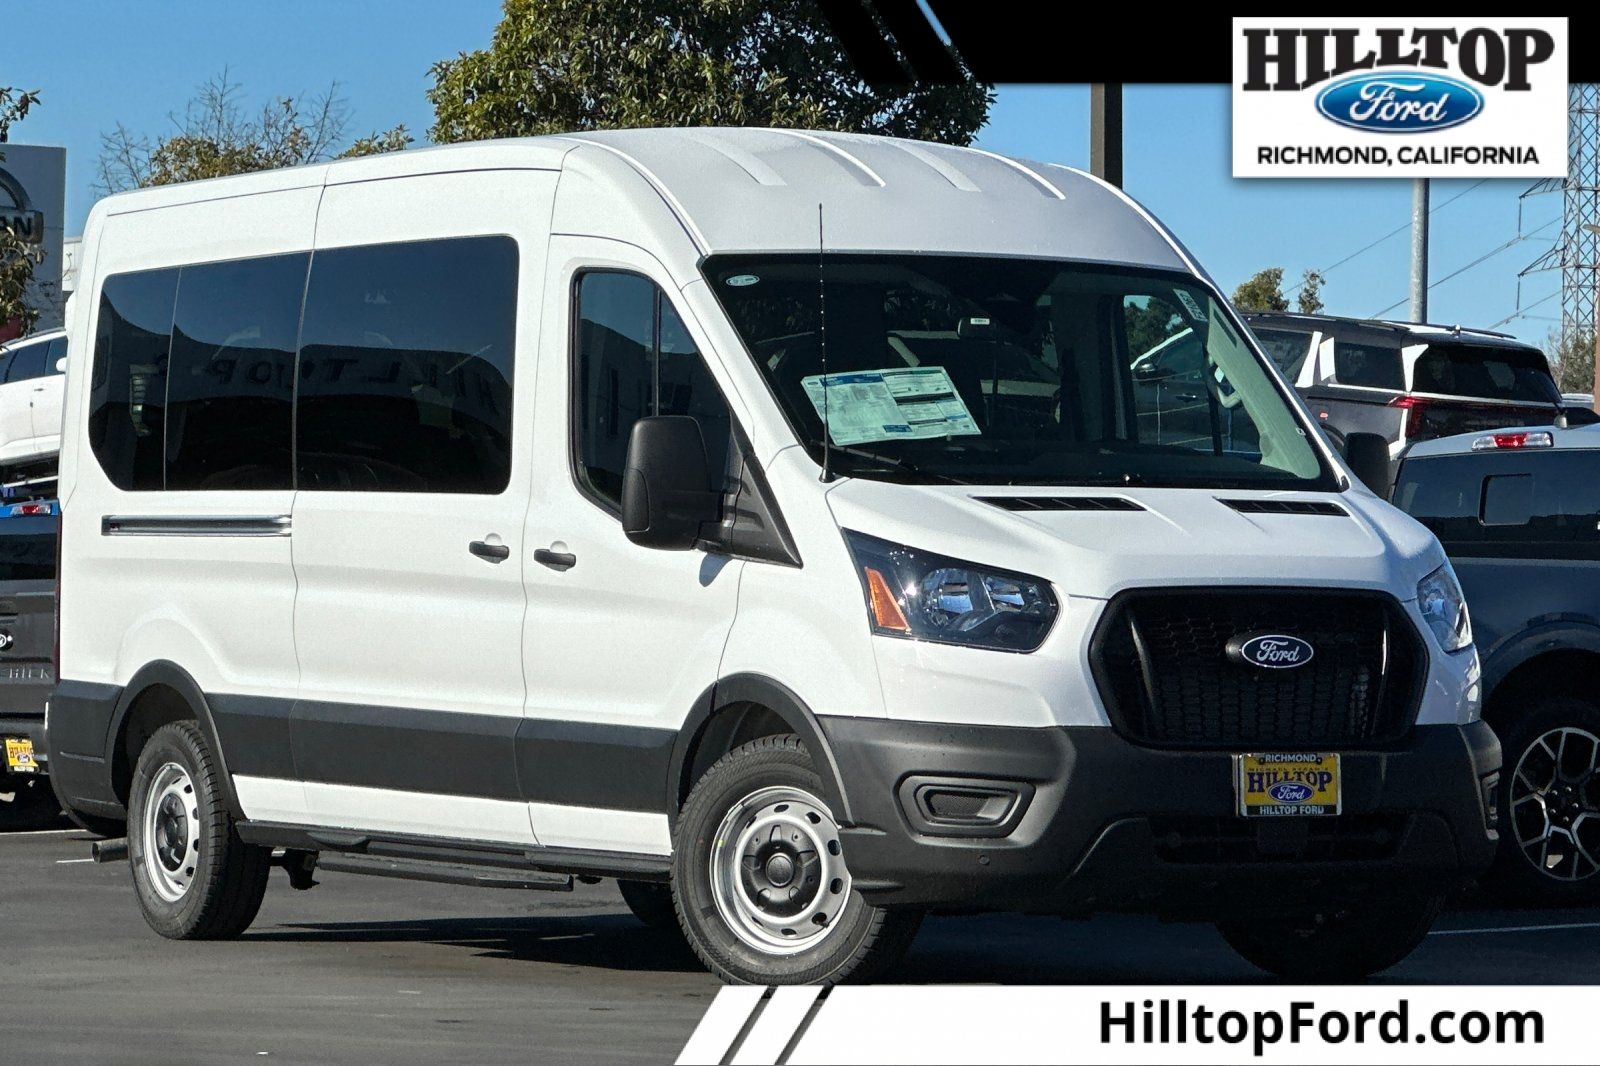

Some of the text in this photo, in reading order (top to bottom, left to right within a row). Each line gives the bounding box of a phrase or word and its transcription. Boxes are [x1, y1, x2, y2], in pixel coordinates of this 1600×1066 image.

[1256, 639, 1300, 662] Ford
[1265, 754, 1317, 763] RICHMOND
[1247, 771, 1333, 793] HILLTOP
[1277, 785, 1305, 800] Ford
[1260, 805, 1324, 815] HILLTOP FORD
